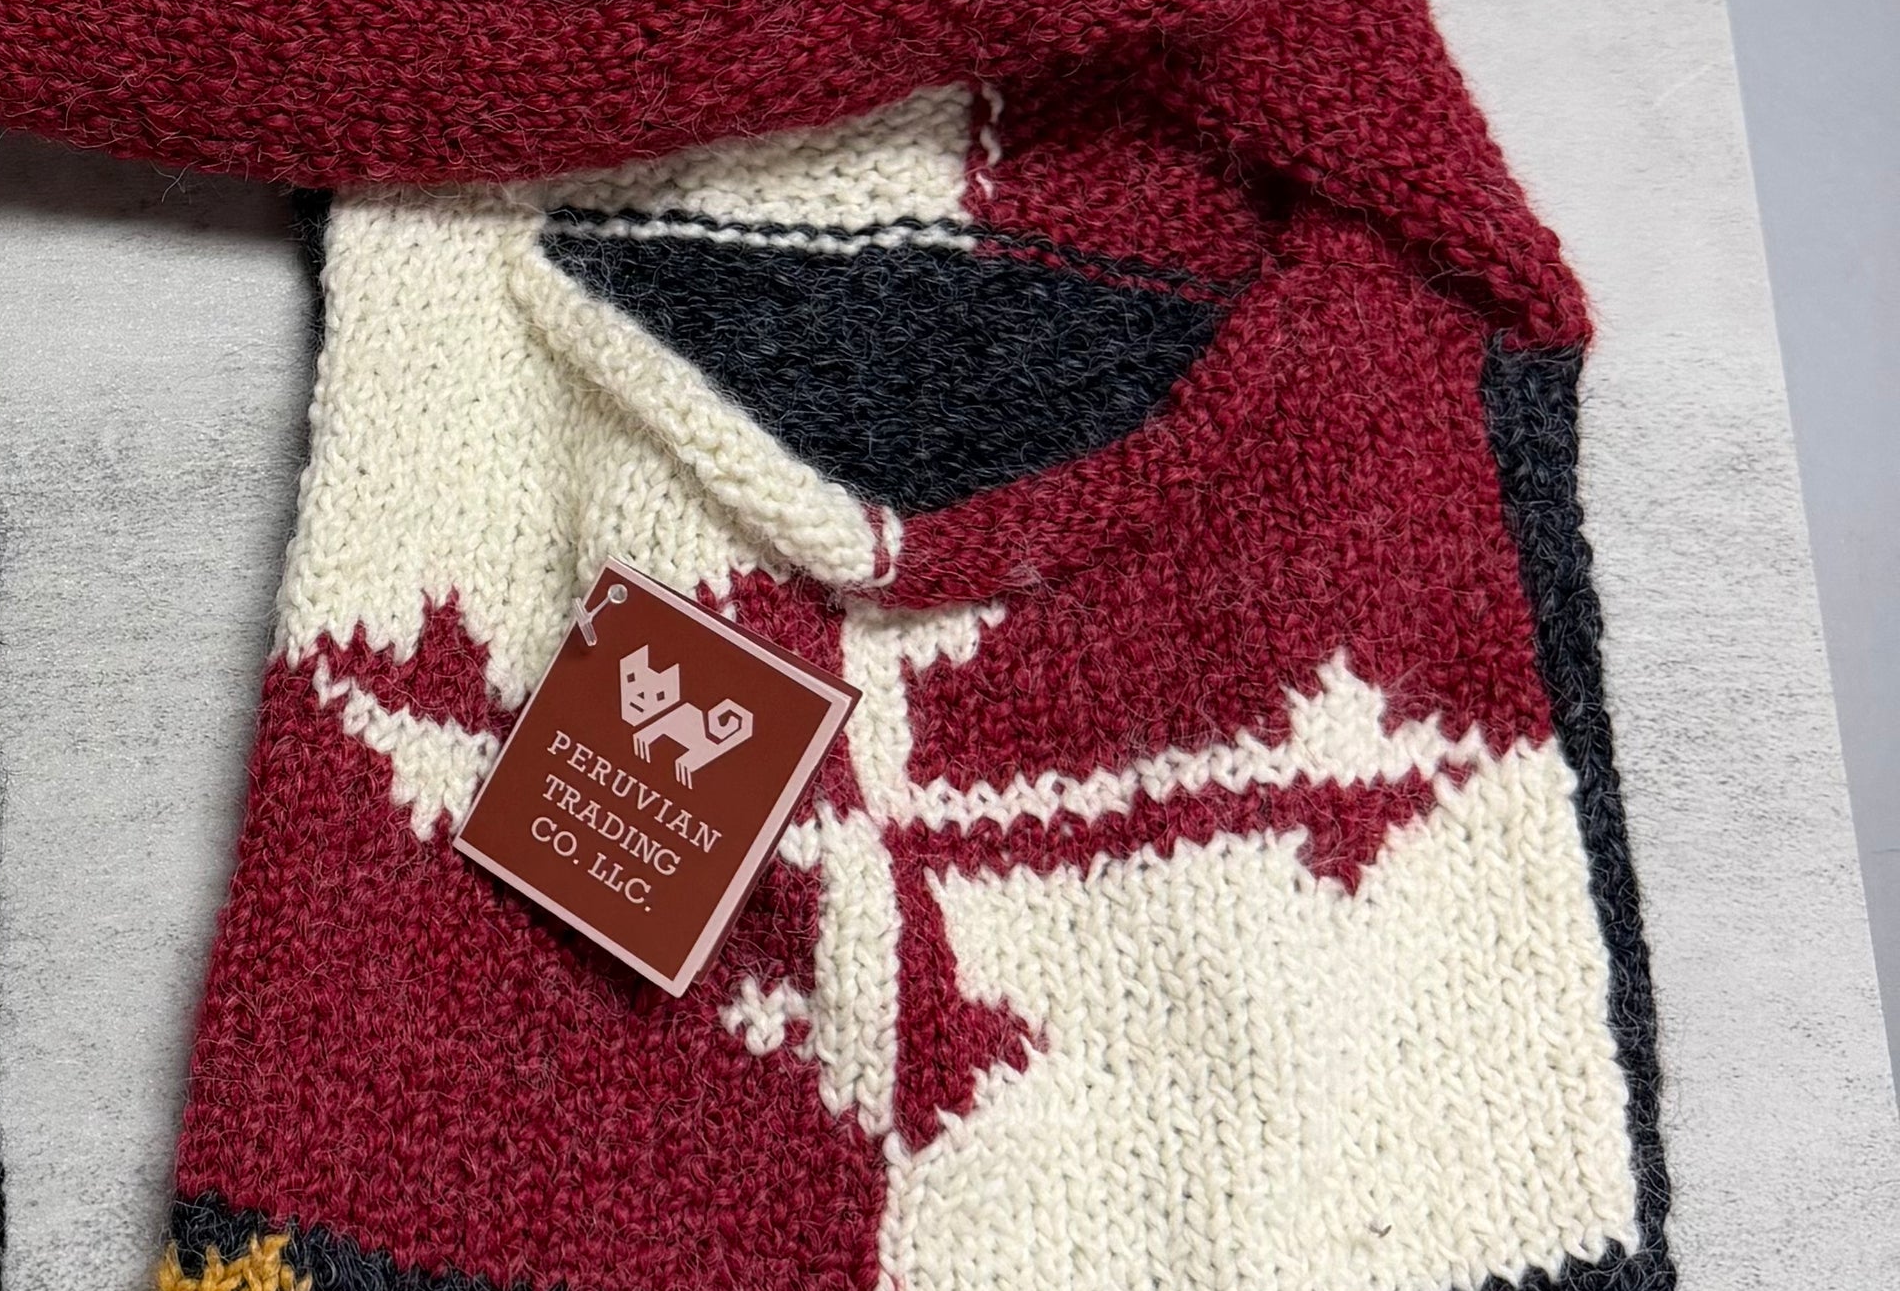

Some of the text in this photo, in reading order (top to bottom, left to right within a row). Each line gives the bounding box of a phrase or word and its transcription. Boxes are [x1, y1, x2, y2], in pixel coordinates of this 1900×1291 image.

[542, 774, 681, 876] TRADING
[547, 730, 722, 853] PERUVIAN
[531, 816, 651, 912] CO. LLC.
